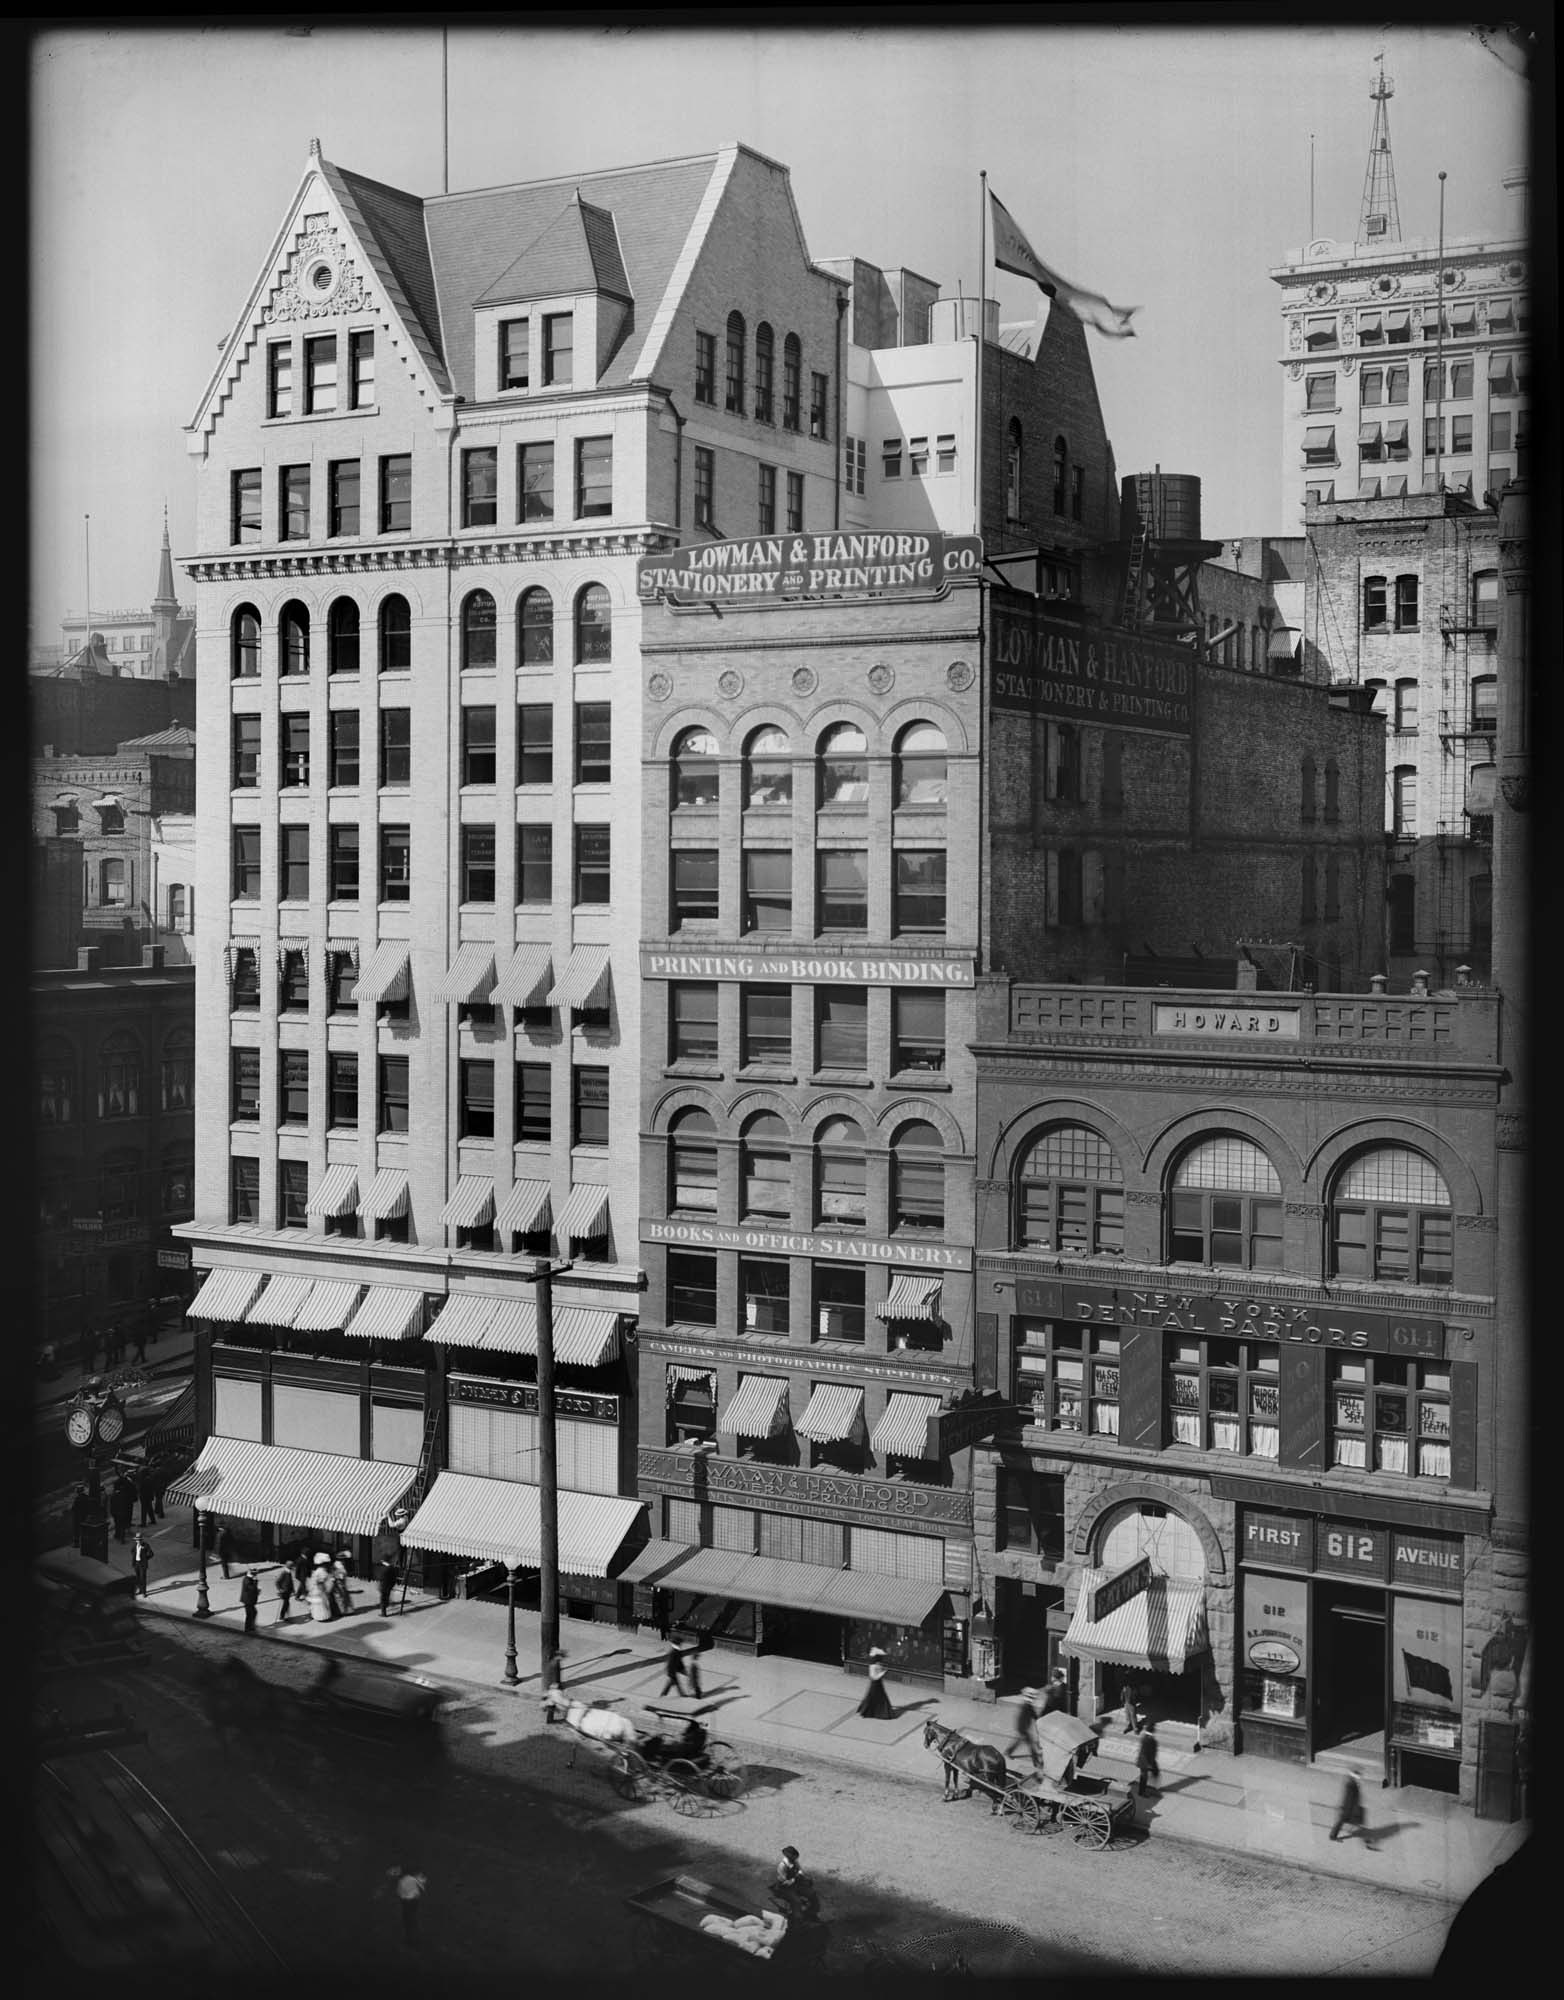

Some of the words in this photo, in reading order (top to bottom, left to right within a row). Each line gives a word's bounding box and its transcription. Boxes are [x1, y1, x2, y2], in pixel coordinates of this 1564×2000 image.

[689, 541, 783, 570] LOWMAN
[790, 538, 807, 562] &
[814, 536, 929, 561] HANFORD
[640, 567, 780, 594] STATIONERY
[783, 574, 803, 586] AND
[809, 558, 933, 589] PRINTING
[944, 550, 981, 571] CO.
[995, 617, 1080, 675] LOWMAN
[1087, 643, 1098, 679] &
[1104, 642, 1187, 695] HANFORD
[1098, 691, 1109, 710] &
[1112, 693, 1171, 720] PRINTING
[650, 956, 753, 976] PRINTING
[759, 961, 788, 974] AND
[791, 959, 857, 978] BOOK
[862, 962, 968, 982] BINDING.
[1175, 1012, 1280, 1032] HOWARD
[650, 1223, 714, 1242] BOOKS
[717, 1231, 740, 1243] AND
[746, 1231, 814, 1251] OFFICE
[820, 1239, 962, 1265] STATIONERY.
[1133, 1292, 1193, 1311] NEW
[1225, 1301, 1308, 1322] YORK
[1076, 1302, 1206, 1331] DENTAL
[1223, 1316, 1369, 1348] PARLORS
[650, 1342, 714, 1357] CAMERAS
[719, 1350, 734, 1358] AND
[738, 1352, 857, 1374] PHOTOGRAPHIC
[864, 1366, 959, 1384] SUPPLIES.
[675, 1458, 783, 1486] LOWMAN
[789, 1475, 799, 1488] &
[806, 1477, 929, 1506] HANFORD
[746, 1495, 783, 1508] OFFICE
[858, 1514, 889, 1526] LOOSE
[810, 1493, 888, 1511] PRINTING
[1248, 1525, 1301, 1547] FIRST
[1327, 1532, 1374, 1562] 612
[1395, 1545, 1460, 1570] AVENUE
[1263, 1604, 1286, 1617] 612
[1415, 1628, 1439, 1642] 612
